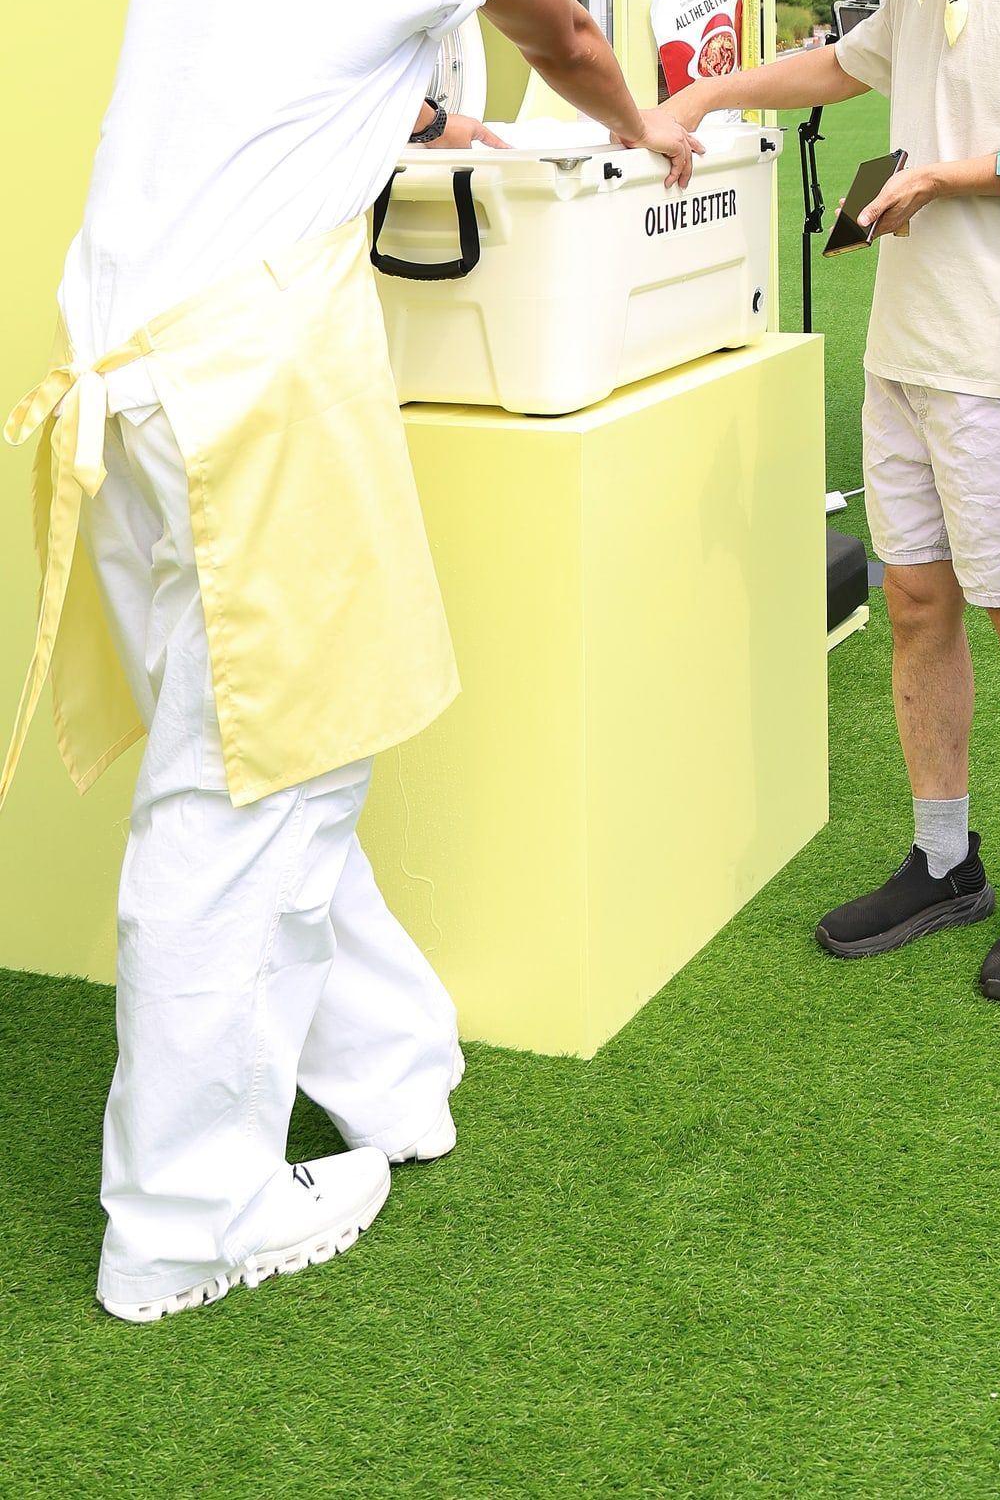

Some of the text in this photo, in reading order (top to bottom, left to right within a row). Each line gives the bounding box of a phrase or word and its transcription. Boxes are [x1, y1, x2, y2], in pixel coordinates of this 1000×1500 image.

[675, 13, 692, 31] ALL
[688, 3, 705, 22] THE
[645, 189, 737, 237] OLIVE BETTER
